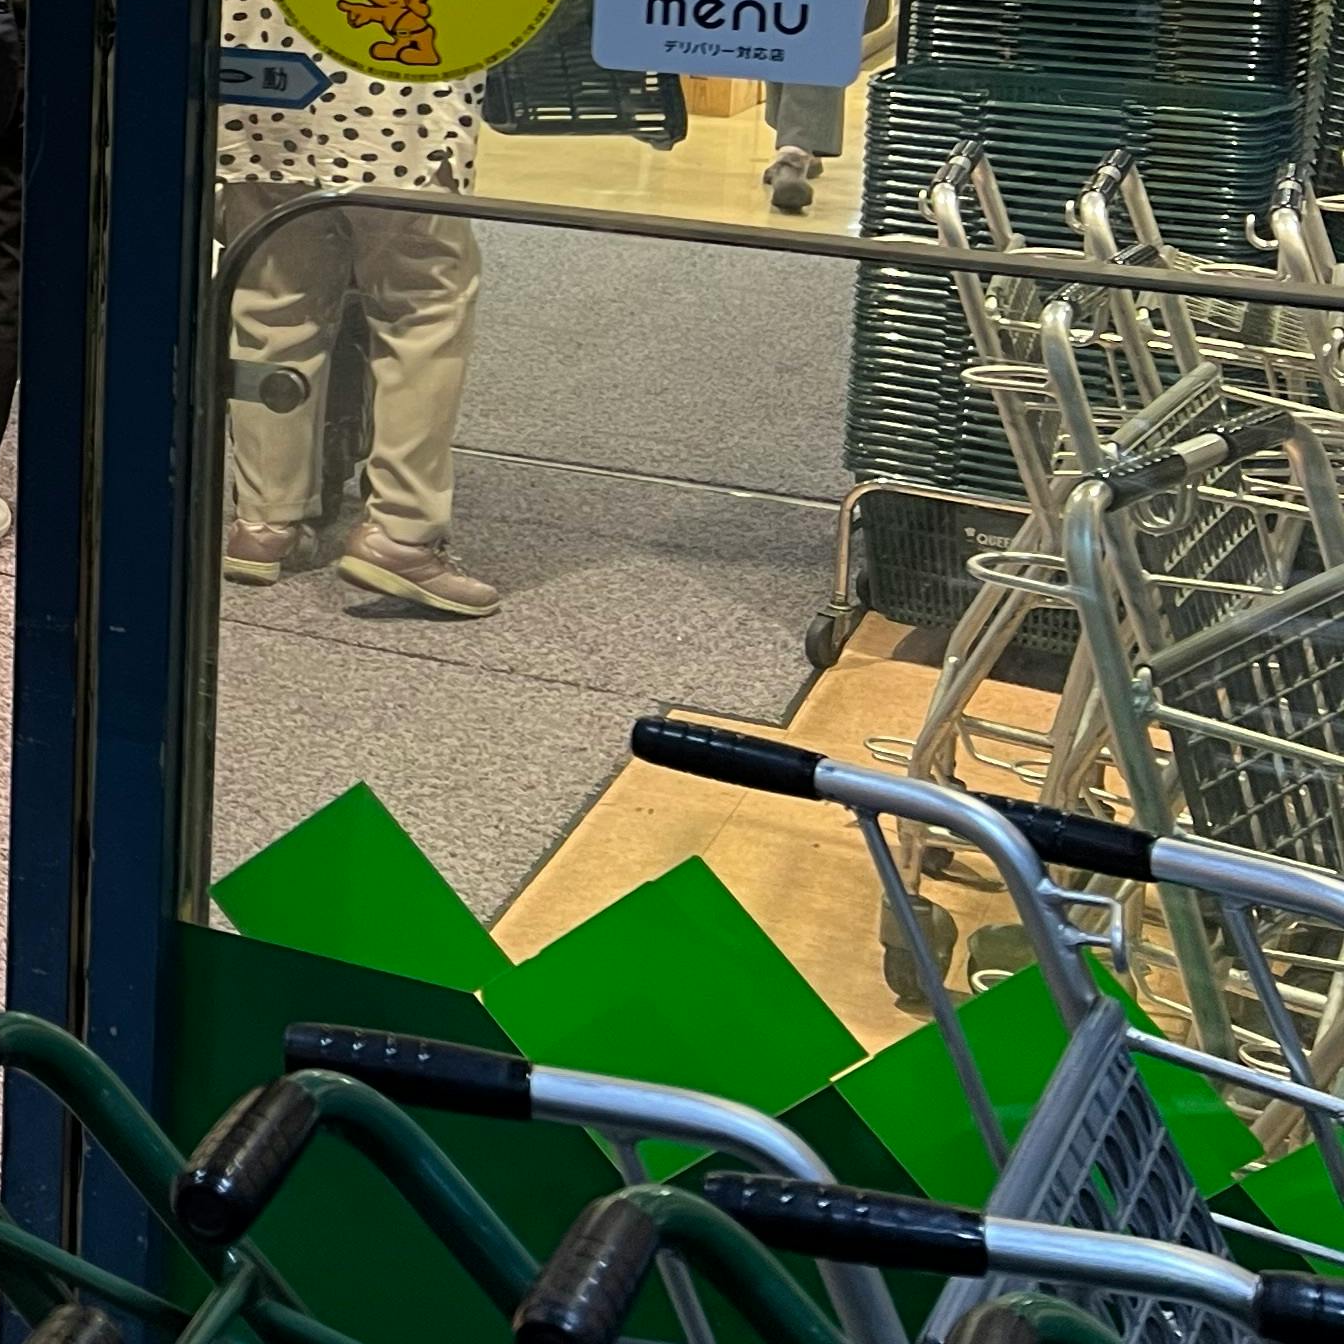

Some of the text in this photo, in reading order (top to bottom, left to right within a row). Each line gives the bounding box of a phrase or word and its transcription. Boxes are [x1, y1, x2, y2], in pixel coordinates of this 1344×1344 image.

[663, 39, 785, 63] デリバリー対応店
